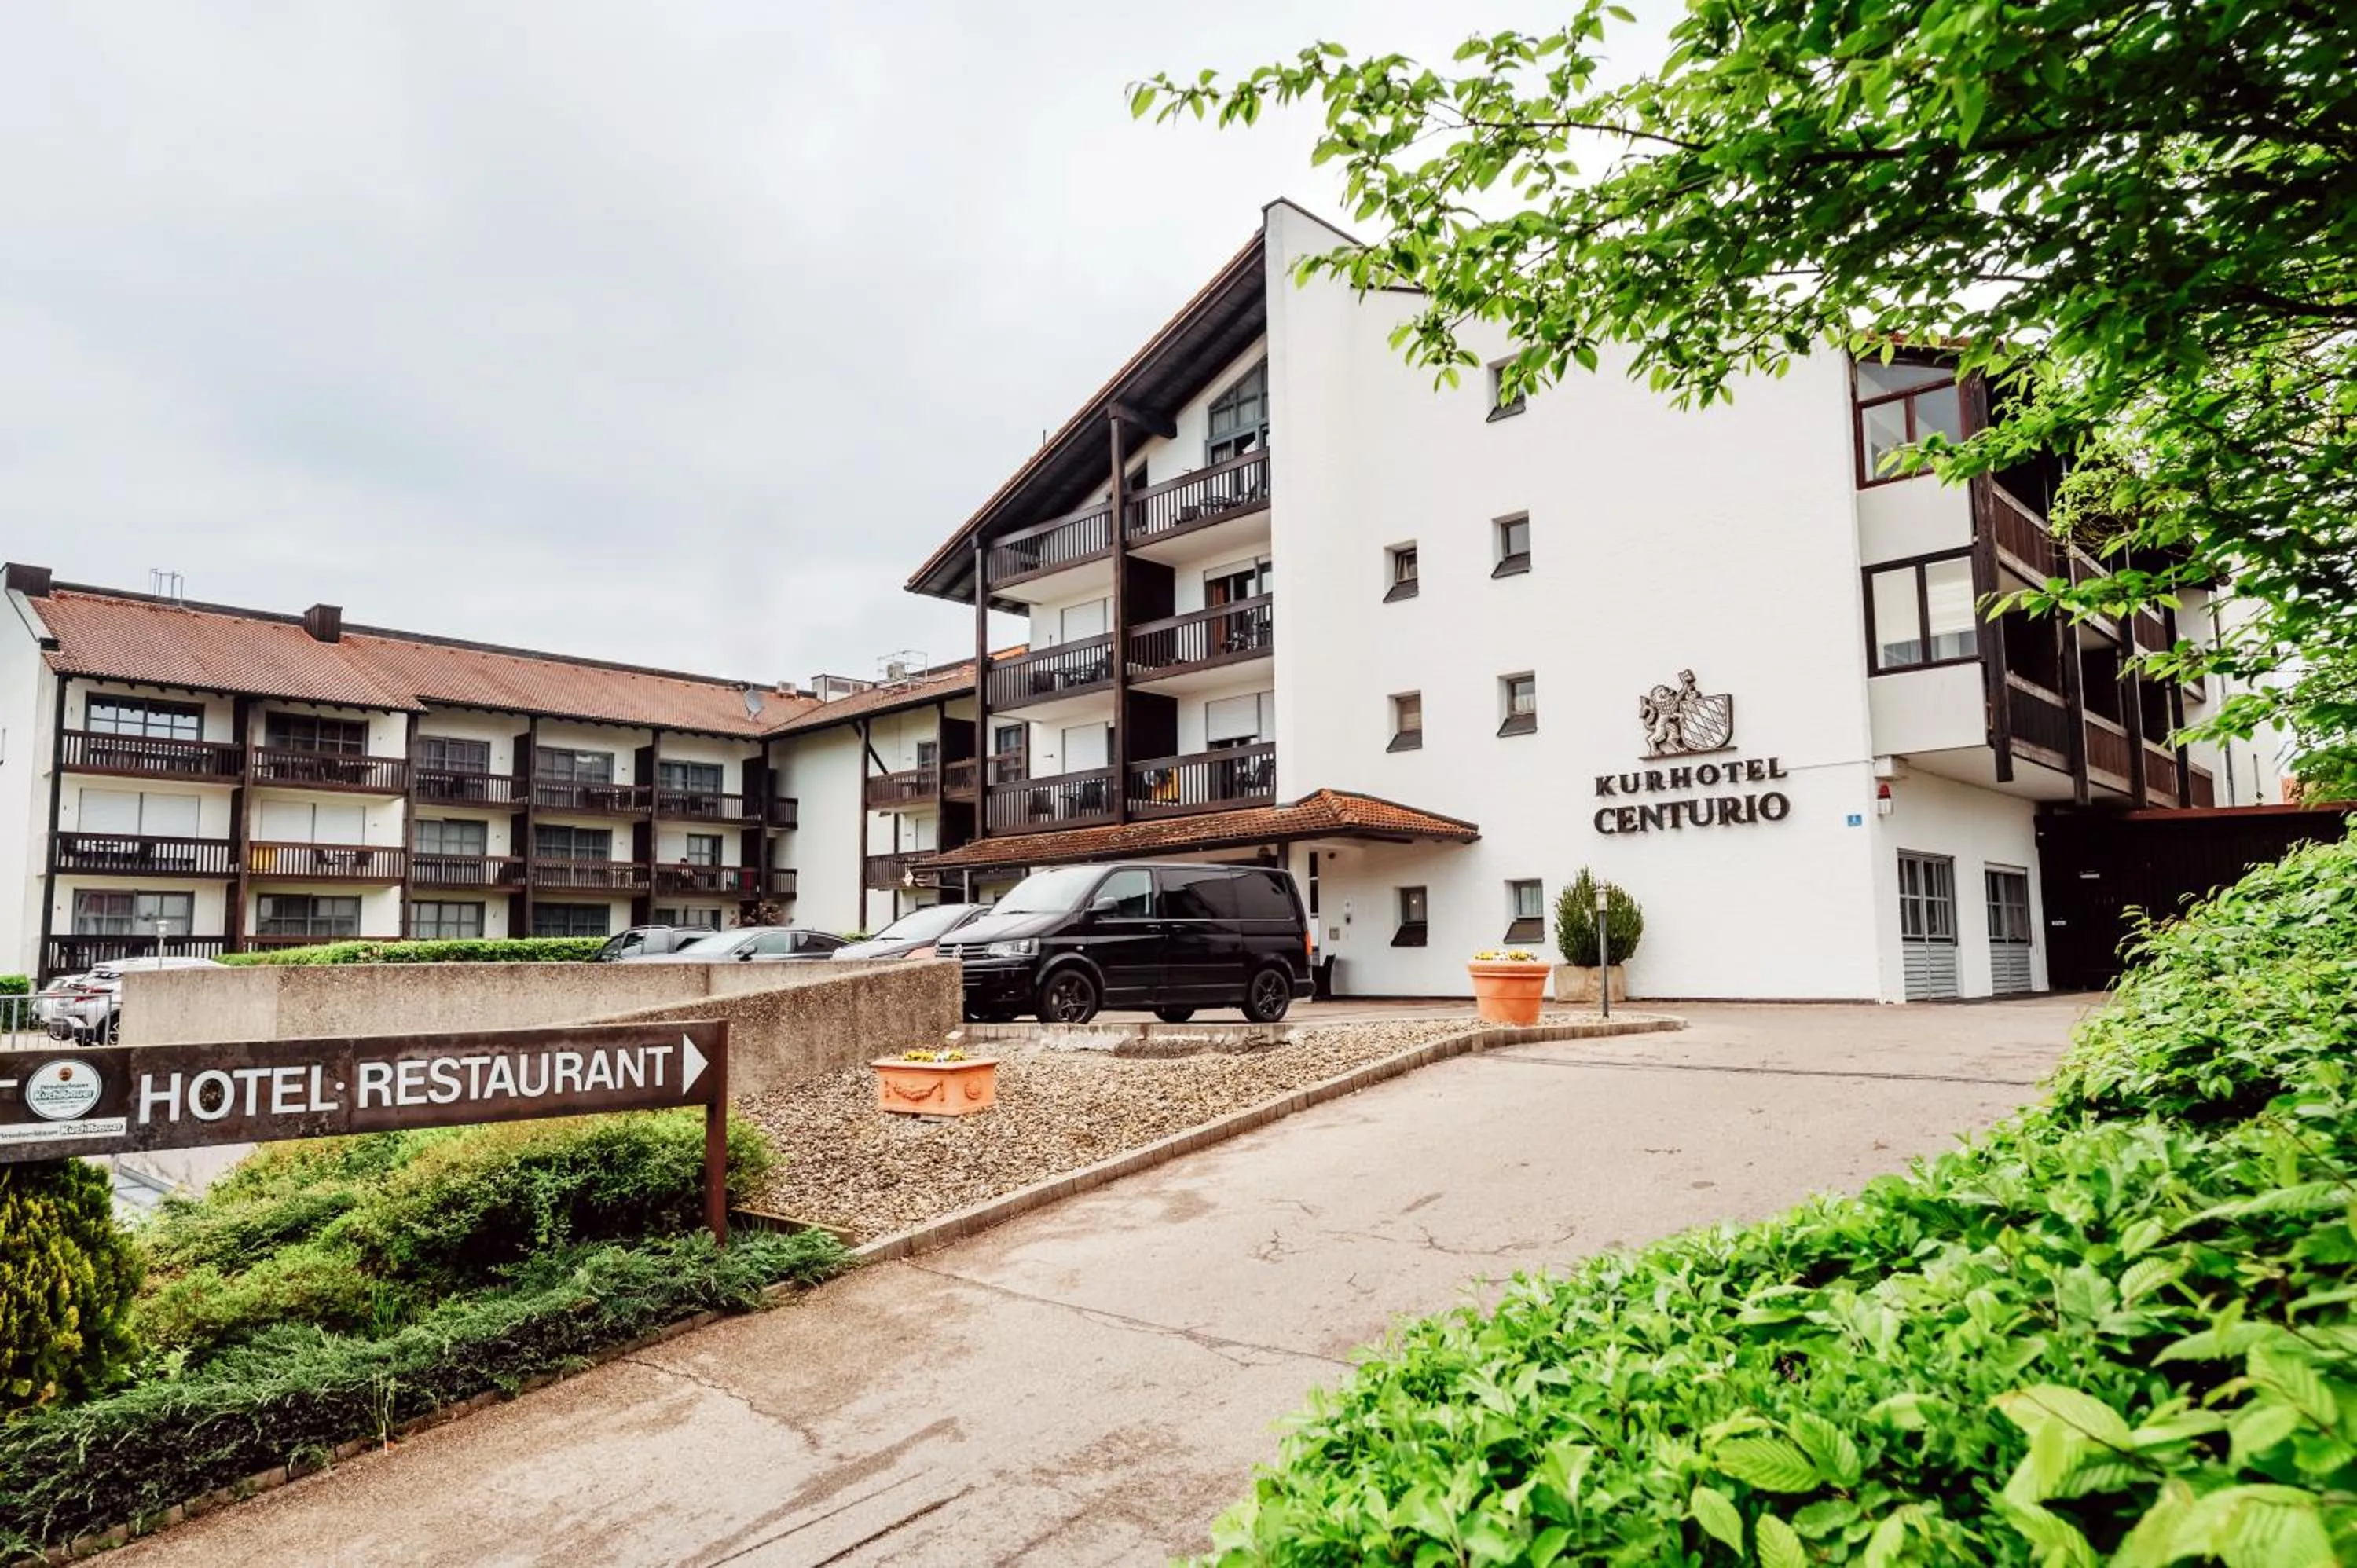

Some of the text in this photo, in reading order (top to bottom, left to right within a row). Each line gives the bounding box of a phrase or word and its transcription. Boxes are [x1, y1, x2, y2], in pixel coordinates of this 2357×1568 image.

[1595, 757, 1787, 797] KURHOTEL
[1594, 792, 1791, 834] CENTURIO
[138, 1046, 674, 1124] HOTEL RESTAURANT
